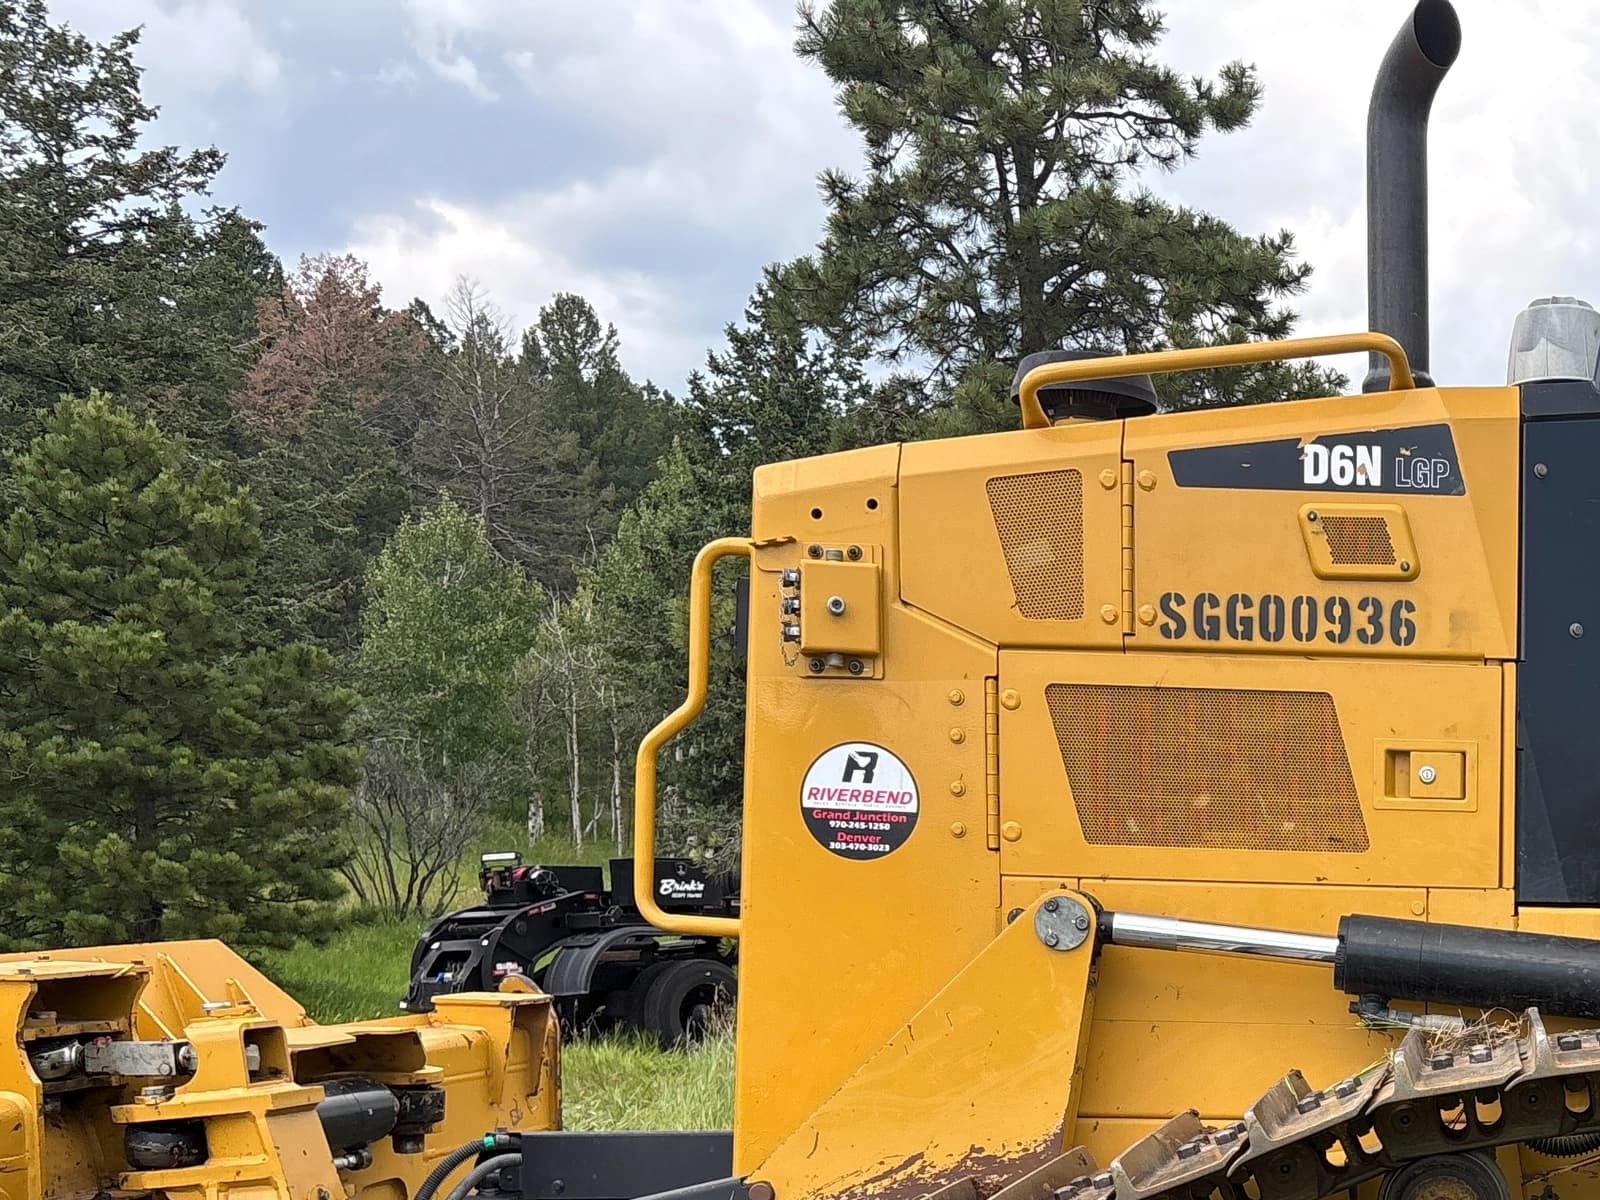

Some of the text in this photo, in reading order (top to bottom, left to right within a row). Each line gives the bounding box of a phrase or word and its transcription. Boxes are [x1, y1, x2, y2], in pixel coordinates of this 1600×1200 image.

[1303, 444, 1450, 489] D6N LGP
[1159, 592, 1417, 647] SGG00936
[807, 786, 913, 805] RIVERBEND
[812, 809, 908, 823] Grand Junction
[836, 831, 882, 843] Denver
